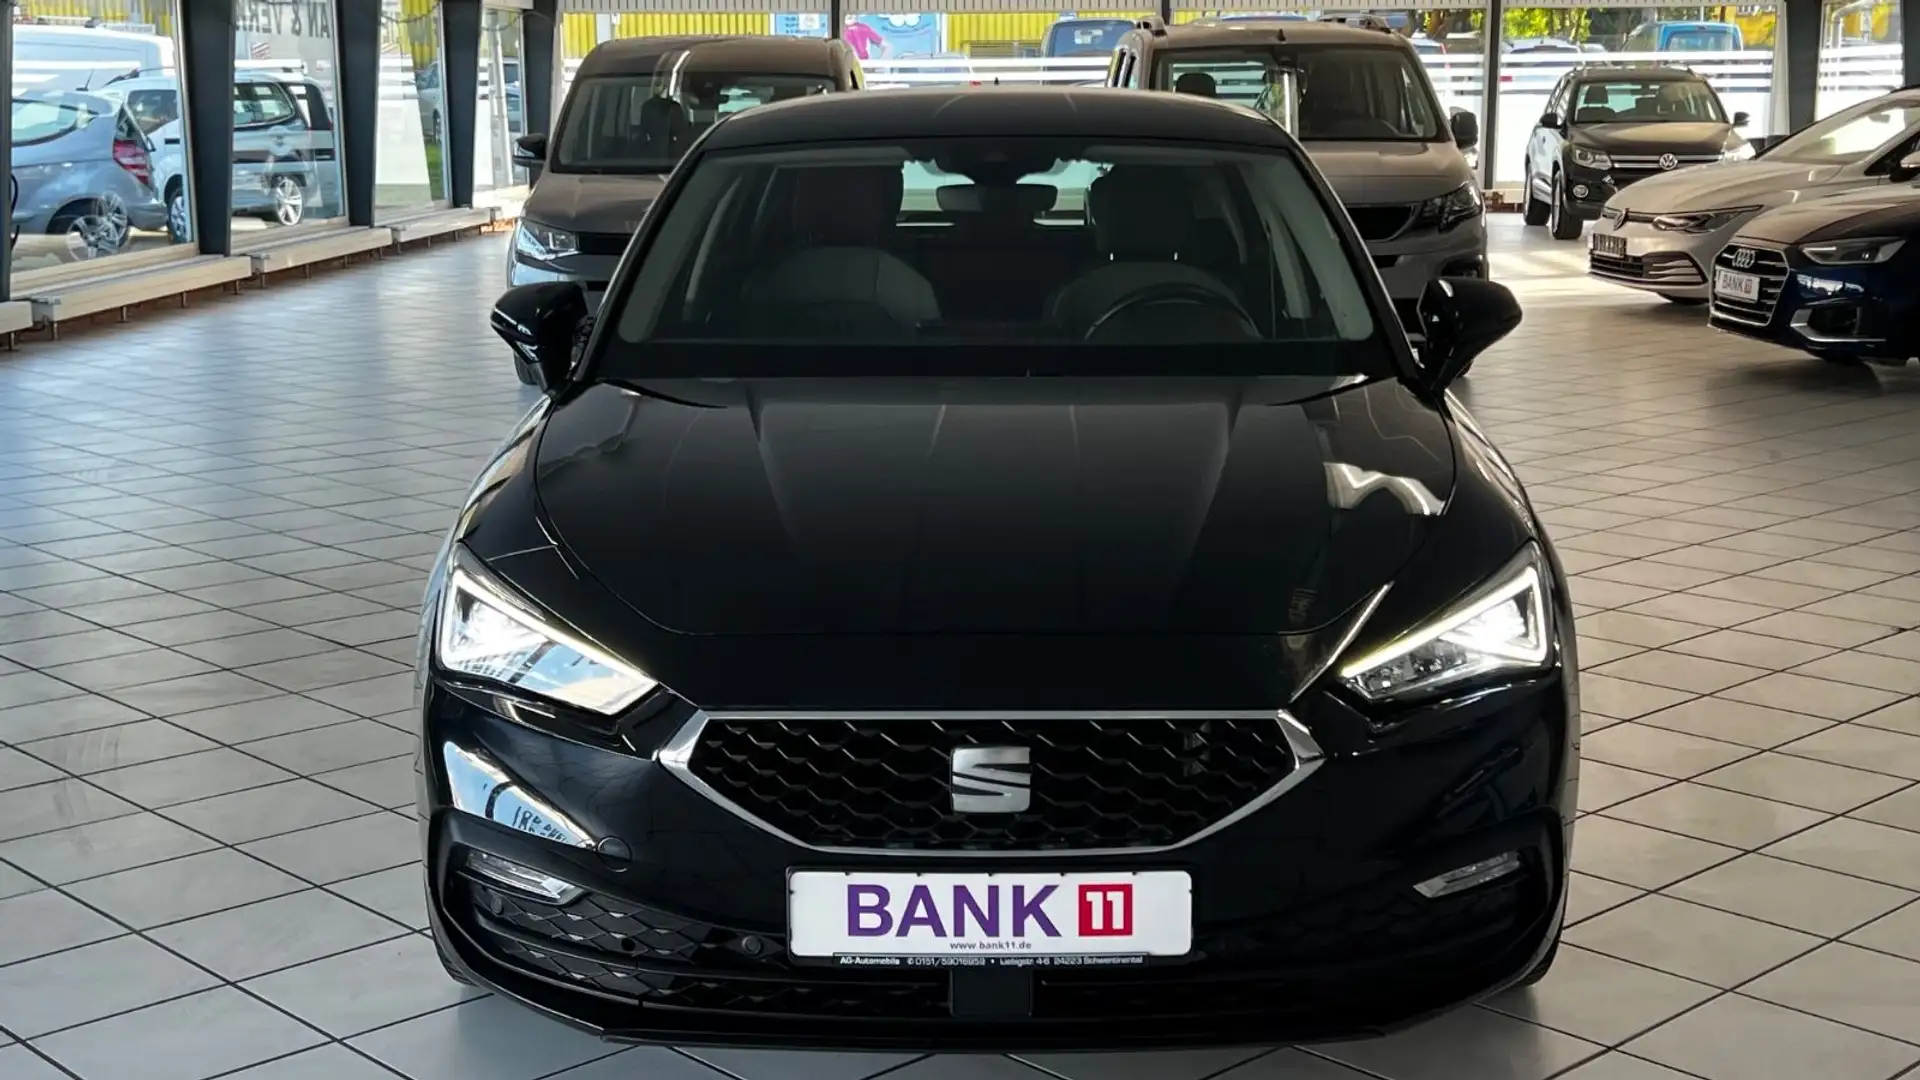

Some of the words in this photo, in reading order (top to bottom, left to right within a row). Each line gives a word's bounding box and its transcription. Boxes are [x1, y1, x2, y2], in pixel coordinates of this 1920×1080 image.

[1722, 274, 1744, 292] BANK
[847, 884, 1061, 937] BANK
[1085, 890, 1127, 931] 11
[950, 941, 1032, 951] www.bank11.de
